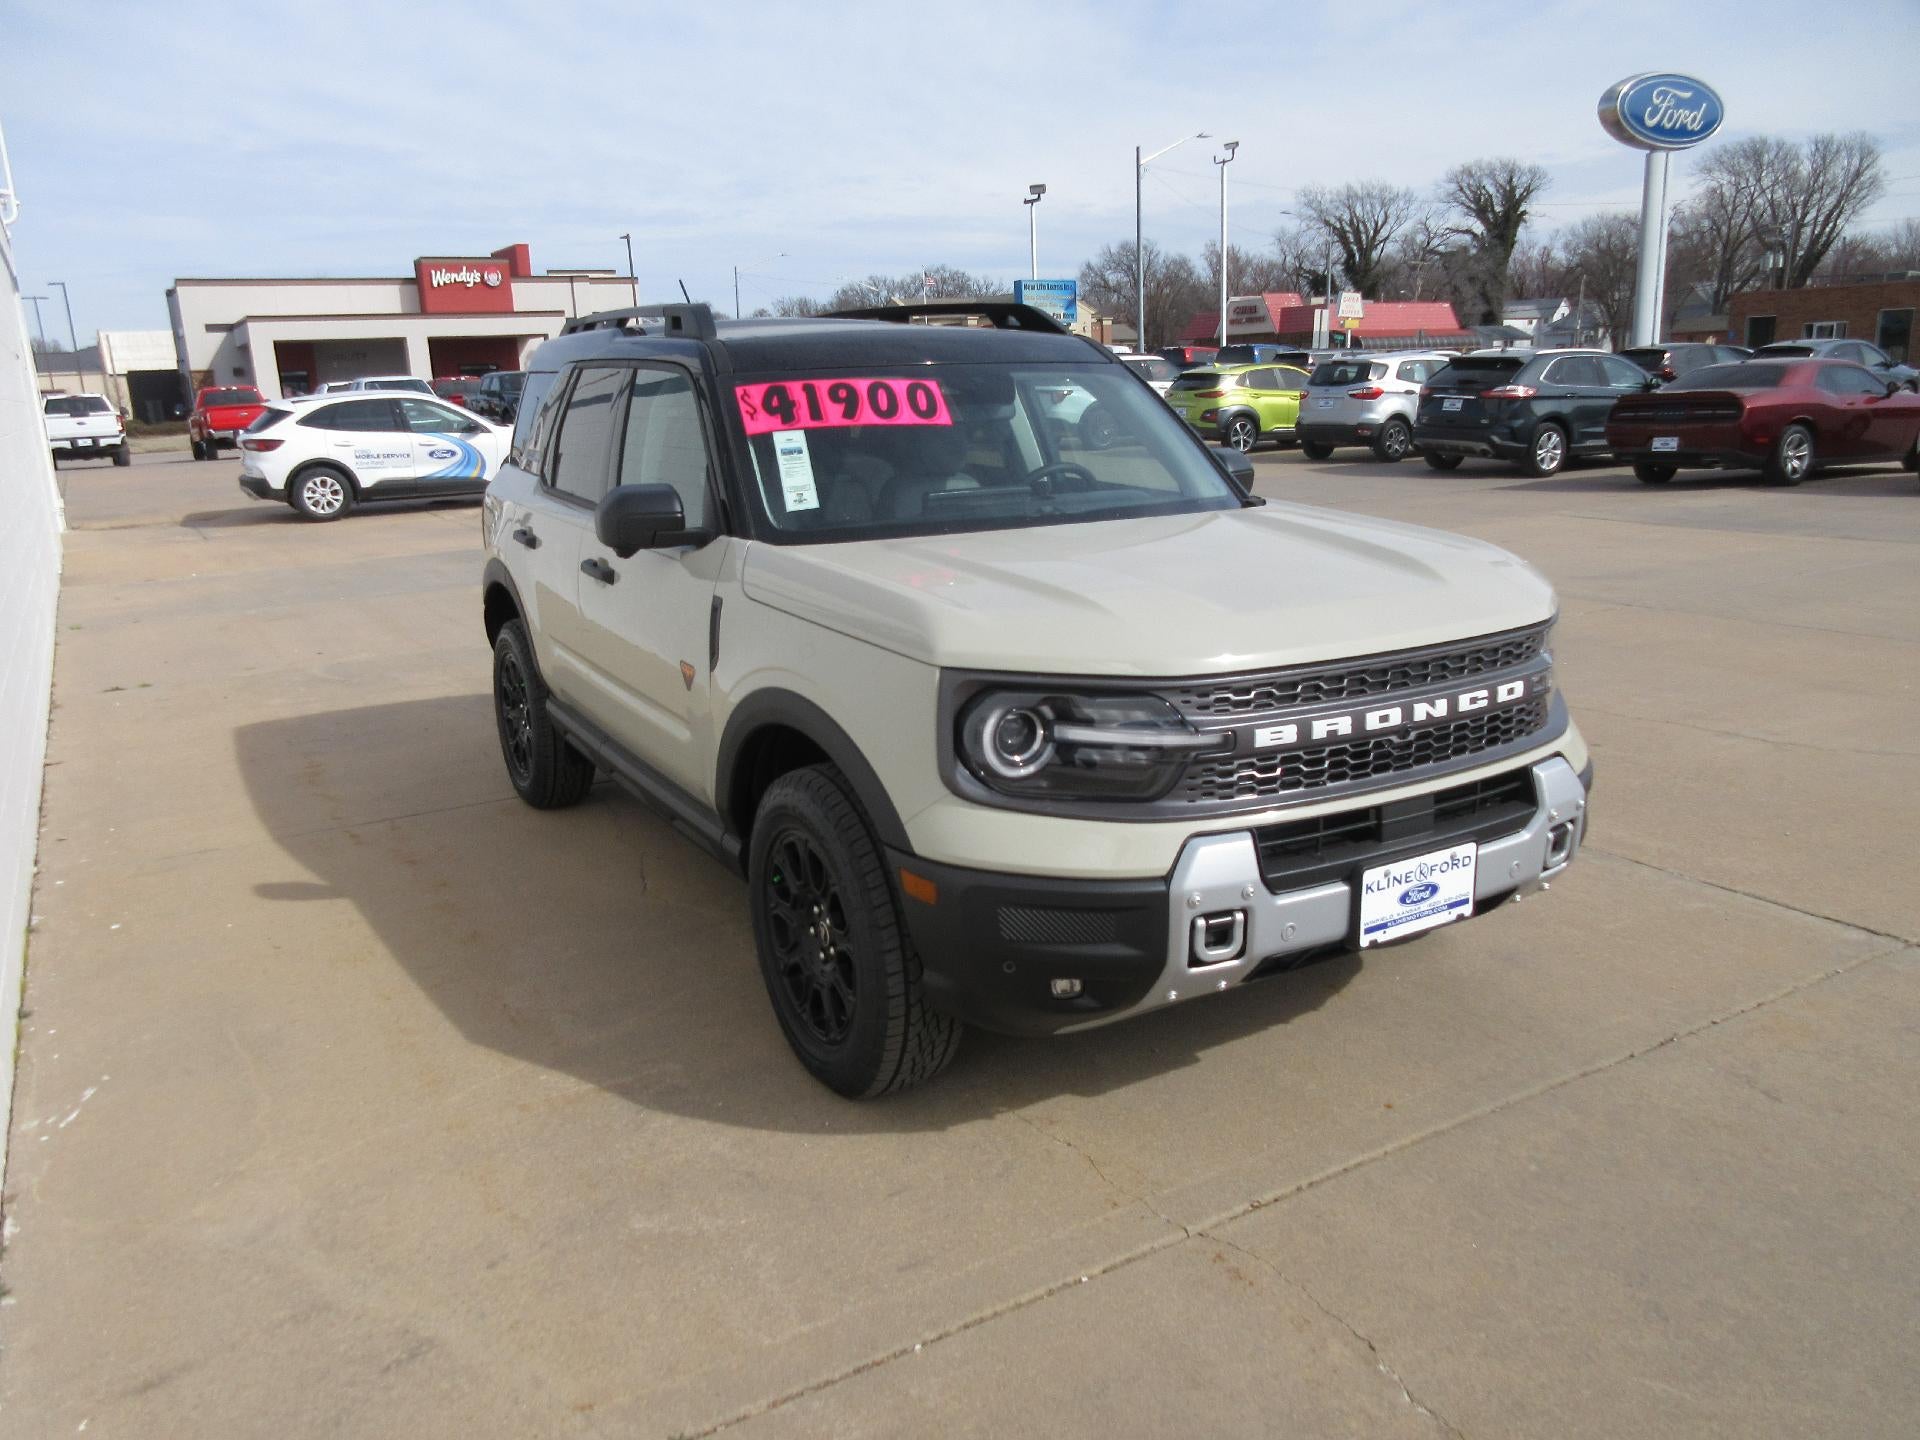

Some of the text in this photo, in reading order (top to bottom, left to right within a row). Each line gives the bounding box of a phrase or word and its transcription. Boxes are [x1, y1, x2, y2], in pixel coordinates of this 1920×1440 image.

[1644, 86, 1707, 131] Ford
[431, 265, 481, 288] Wendy's
[433, 448, 452, 458] Ford
[1254, 680, 1525, 748] BRONCO
[1365, 871, 1414, 895] KLINE
[1429, 855, 1472, 877] FORD
[1405, 886, 1432, 904] Ford
